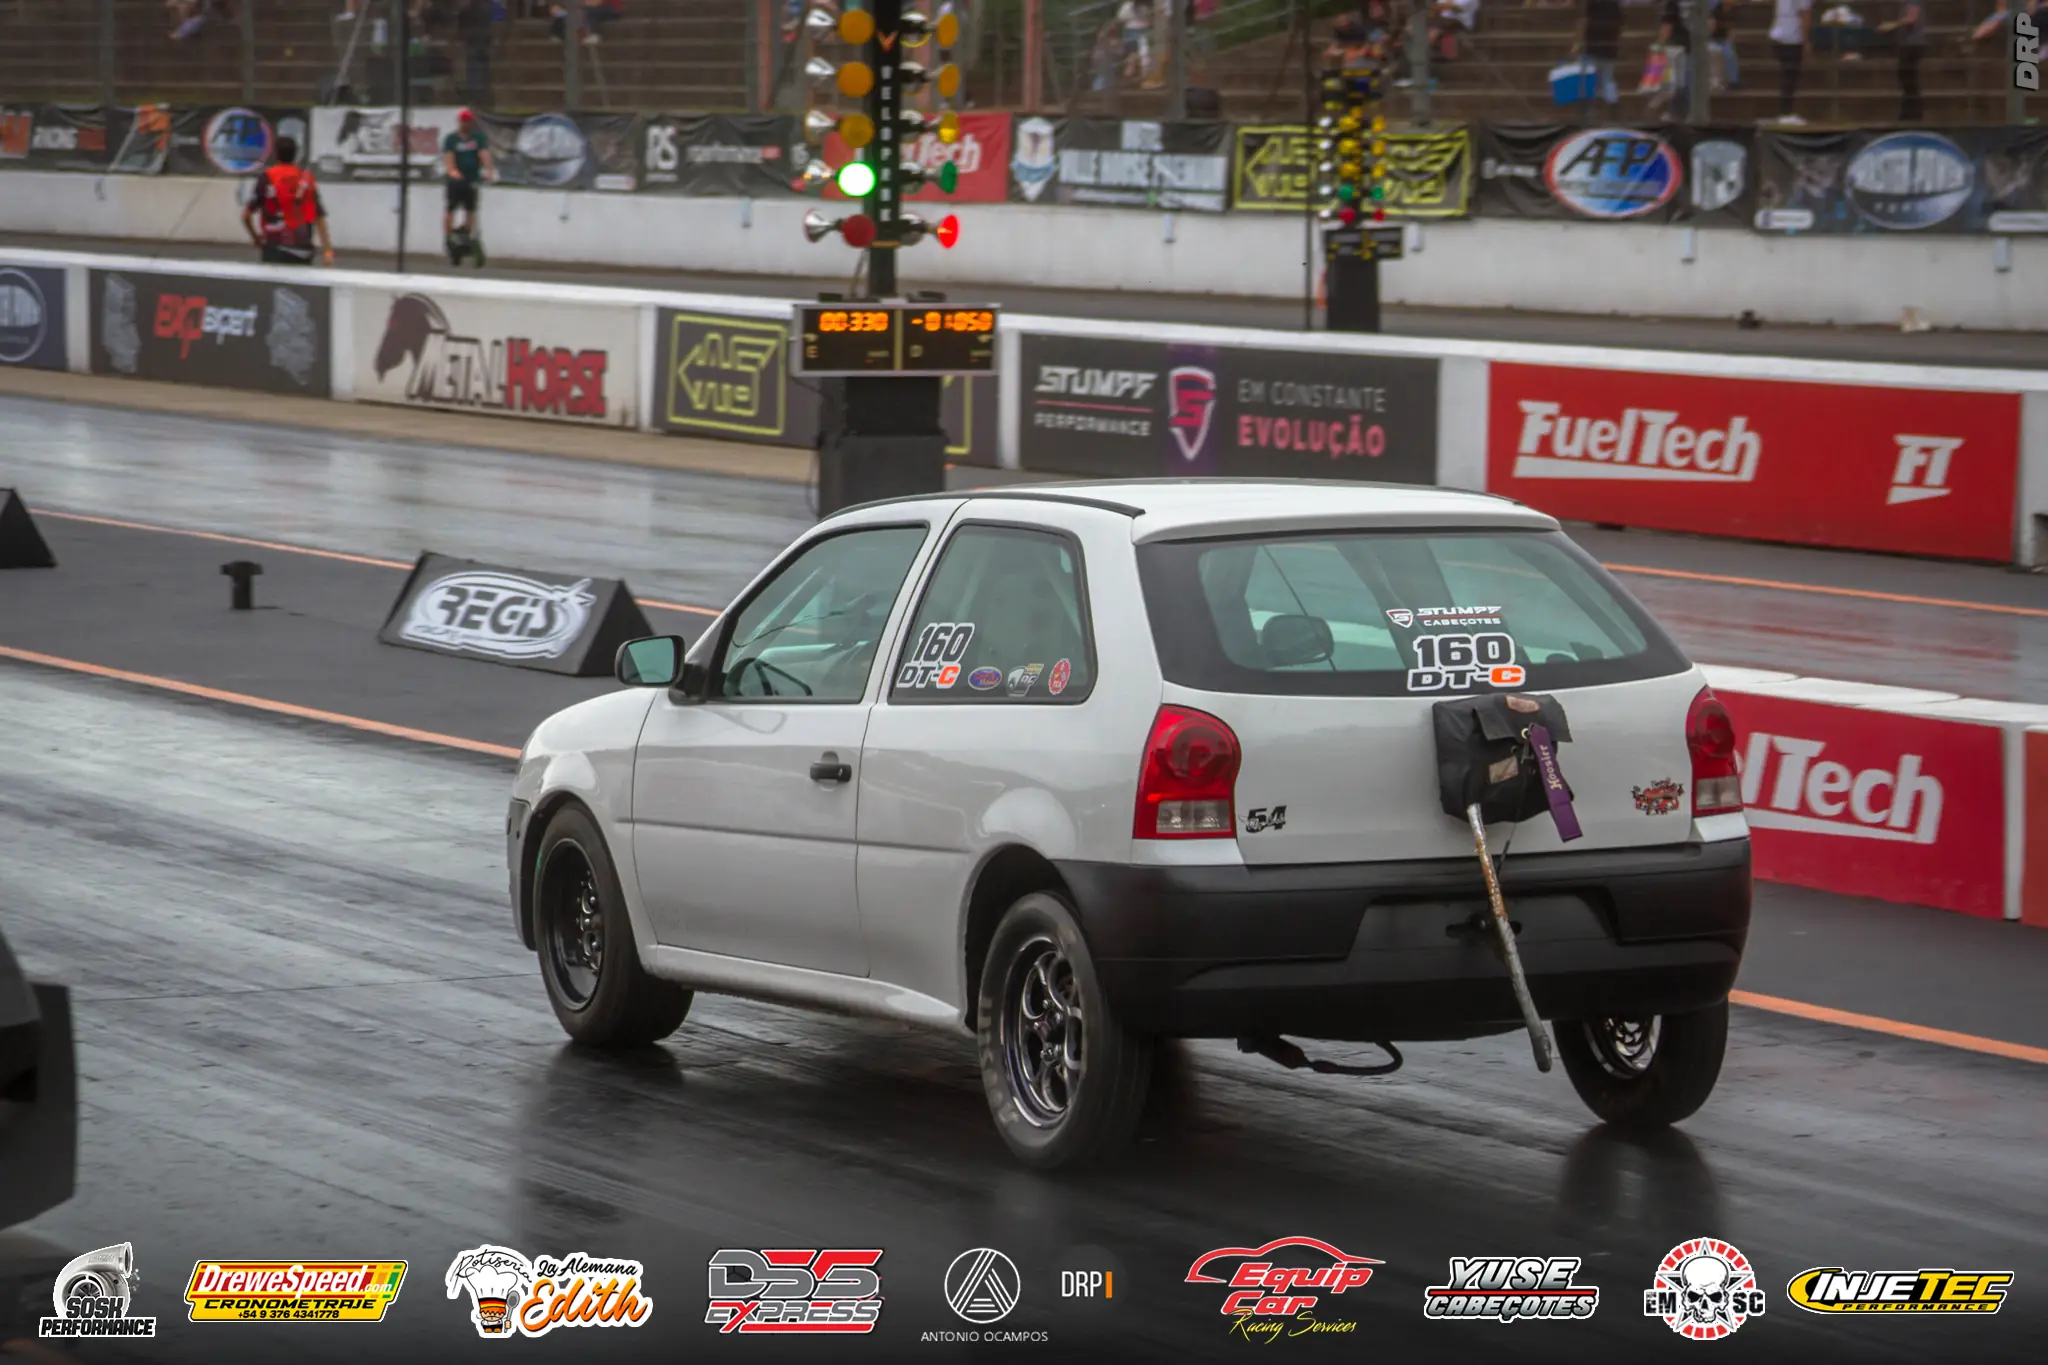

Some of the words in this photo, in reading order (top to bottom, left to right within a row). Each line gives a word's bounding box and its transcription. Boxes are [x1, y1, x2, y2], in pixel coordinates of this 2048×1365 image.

[1035, 365, 1158, 399] STUMPF
[1238, 379, 1265, 403] EM
[1270, 381, 1387, 413] CONSTANTE
[1034, 412, 1152, 437] PERFORMANCE
[1237, 414, 1387, 458] EVOLUÇÃO
[1514, 400, 1761, 481] FuelTech
[1416, 606, 1502, 617] STUMPF
[1423, 617, 1502, 627] CABEÇOTES
[911, 623, 974, 664] 160
[1413, 632, 1515, 669] 160
[896, 662, 961, 689] DT-C
[1407, 664, 1526, 692] DT-C
[1737, 732, 1944, 845] lTech
